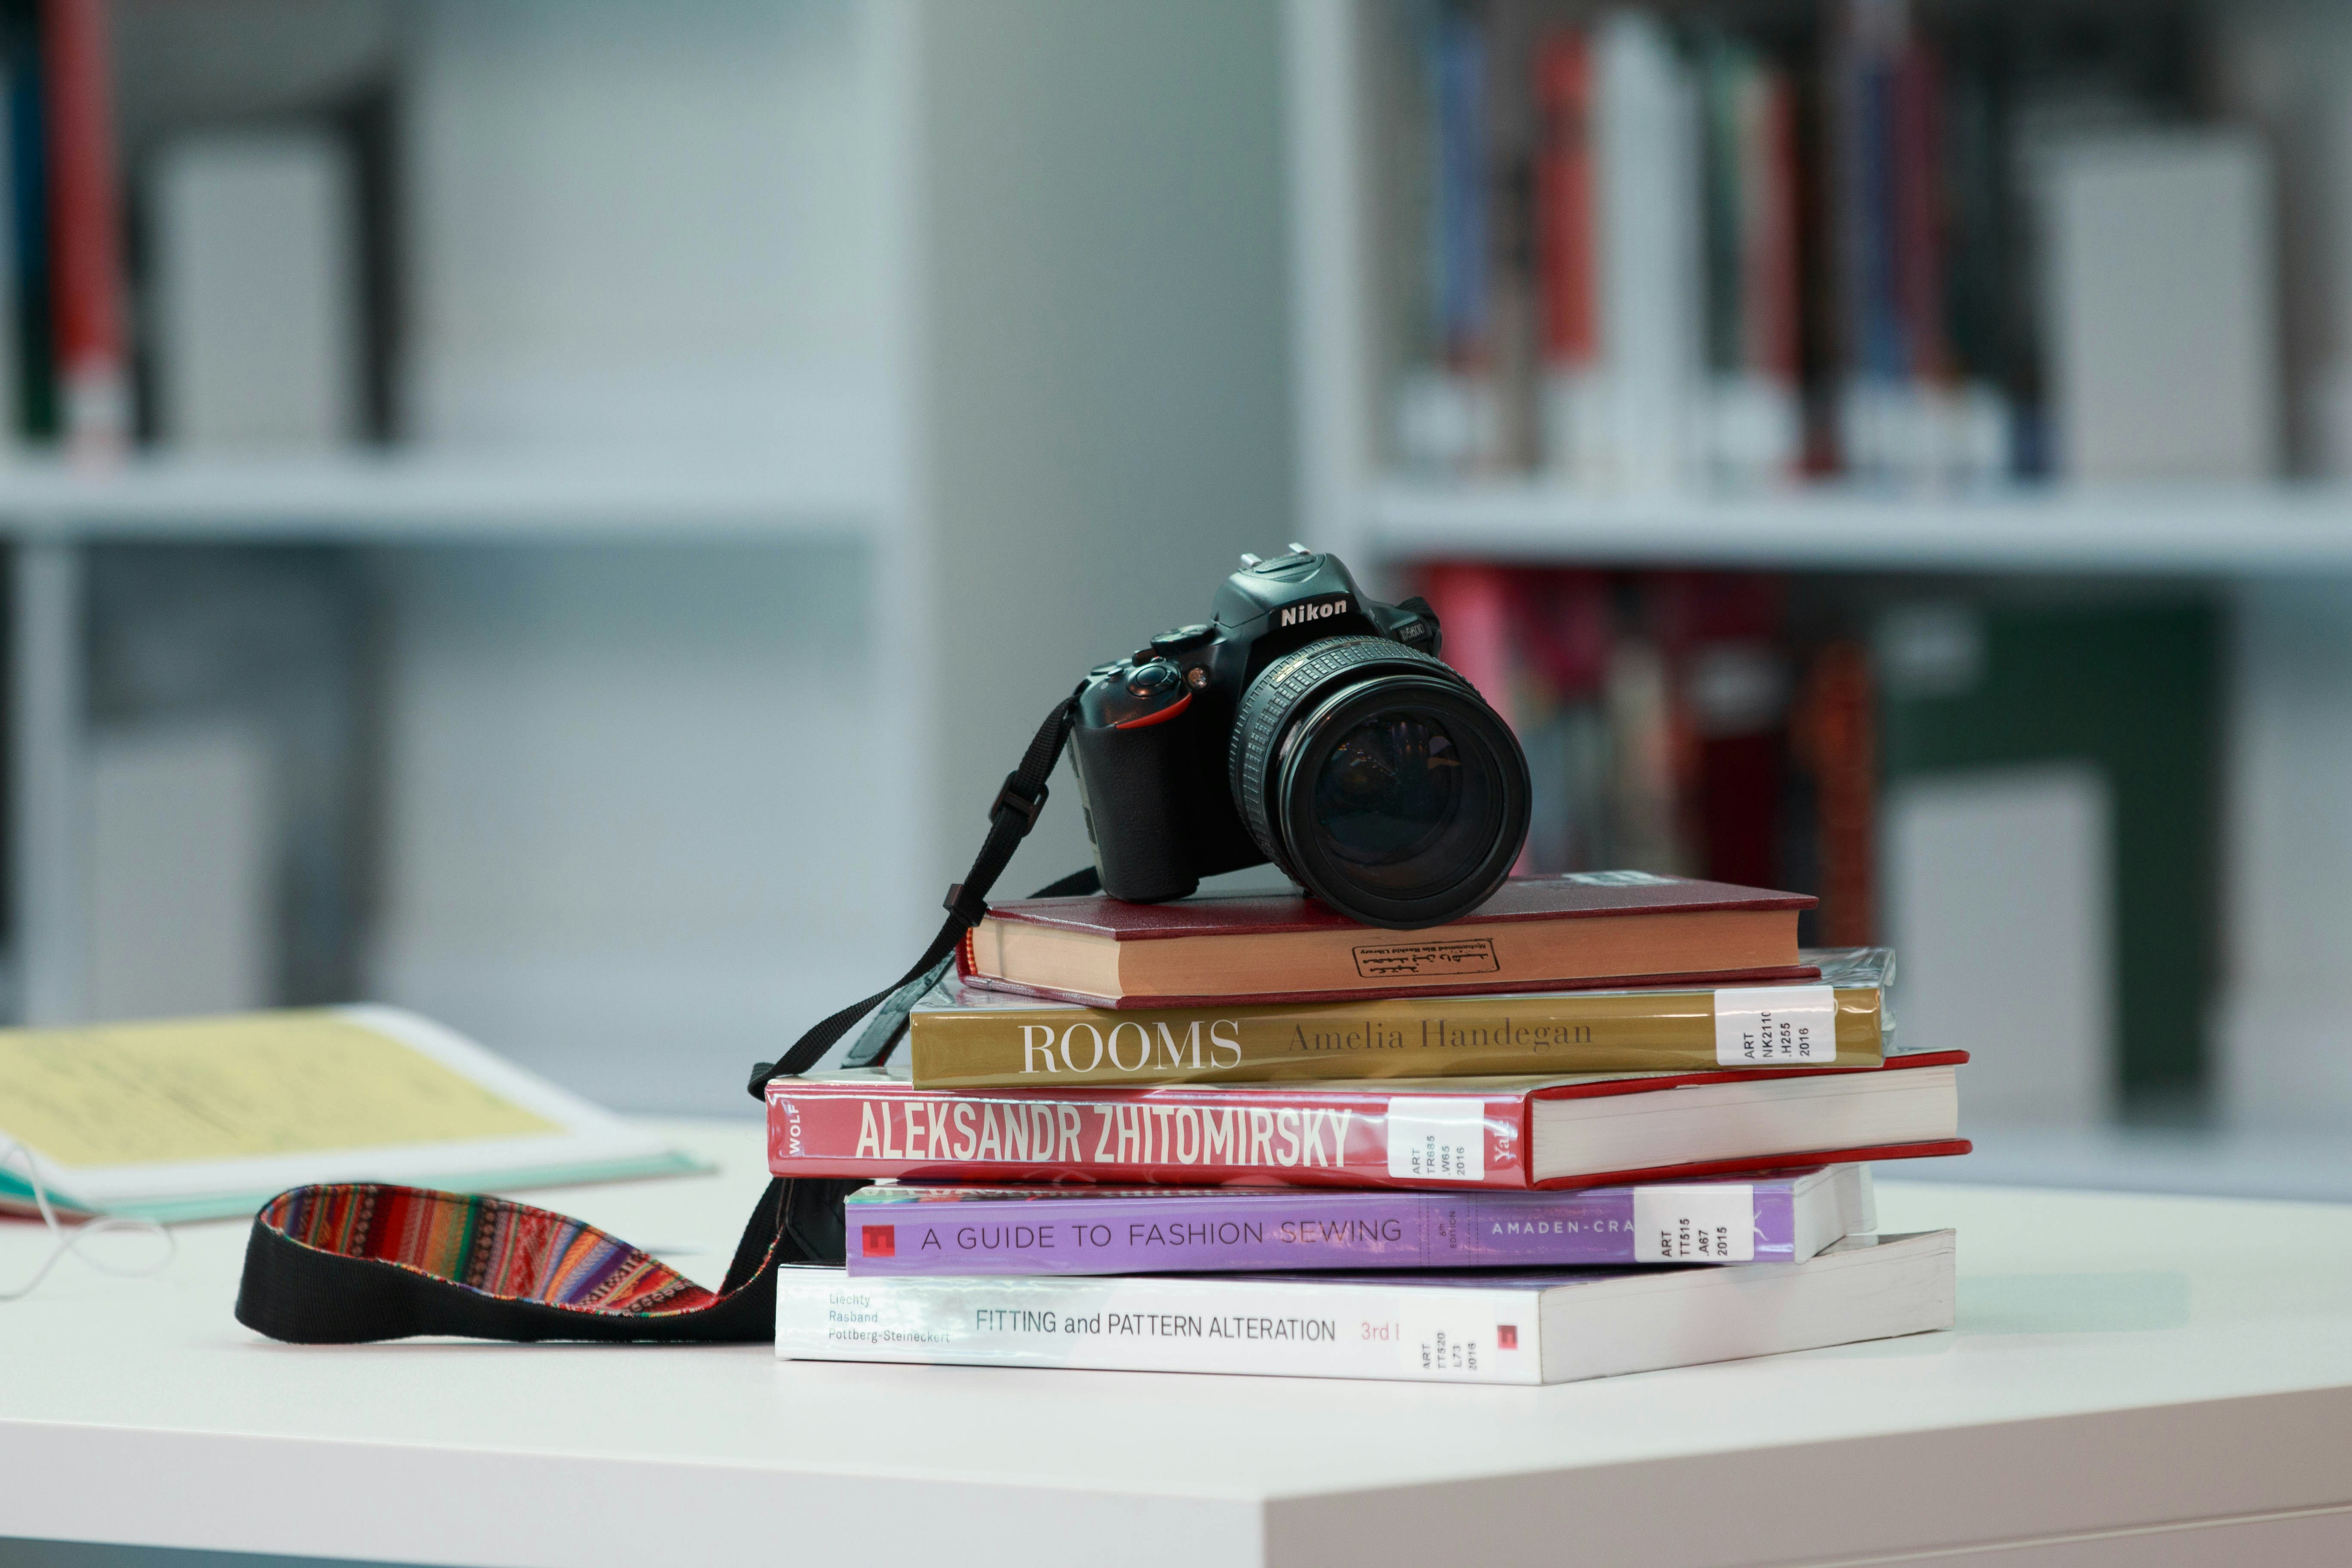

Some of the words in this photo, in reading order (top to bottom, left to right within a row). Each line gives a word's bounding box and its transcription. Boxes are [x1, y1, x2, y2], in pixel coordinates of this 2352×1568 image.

[1281, 600, 1347, 627] Nikon
[1400, 624, 1424, 640] D5600
[1017, 1019, 1241, 1073] ROOMS
[1289, 1021, 1404, 1050] Amelia
[1421, 1017, 1592, 1054] Handegan
[1744, 1033, 1755, 1059] ART
[1781, 1023, 1792, 1057] .H255
[1799, 1028, 1810, 1057] 2016
[789, 1105, 801, 1155] WOLF
[855, 1102, 1082, 1162] ALEKSANDR
[1094, 1105, 1352, 1167] ZHITOMIRSKY
[1494, 1120, 1510, 1163] Yale
[1412, 1148, 1421, 1175] ART
[1427, 1136, 1435, 1175] TR685
[1442, 1146, 1450, 1176] .W65
[1457, 1147, 1465, 1176] 2016
[922, 1228, 941, 1250] A
[957, 1226, 1055, 1249] GUIDE
[1072, 1225, 1111, 1247] TO
[1130, 1222, 1263, 1246] FASHION
[1280, 1219, 1402, 1244] SEWING
[1662, 1231, 1672, 1257] ART
[1680, 1219, 1690, 1257] TT515
[1699, 1230, 1709, 1256] .A67
[1717, 1227, 1727, 1256] 2015
[830, 1293, 870, 1308] Liechty
[829, 1311, 877, 1323] Rasband
[976, 1309, 1056, 1332] FITTING
[1064, 1314, 1100, 1334] and
[1108, 1314, 1202, 1337] PATTERN
[1209, 1317, 1335, 1341] ALTERATION
[1362, 1322, 1389, 1341] 3rd
[829, 1329, 950, 1343] Pottberg-Steineckert
[1422, 1344, 1430, 1369] ART
[1437, 1332, 1446, 1370] TT520
[1468, 1342, 1477, 1371] 2016
